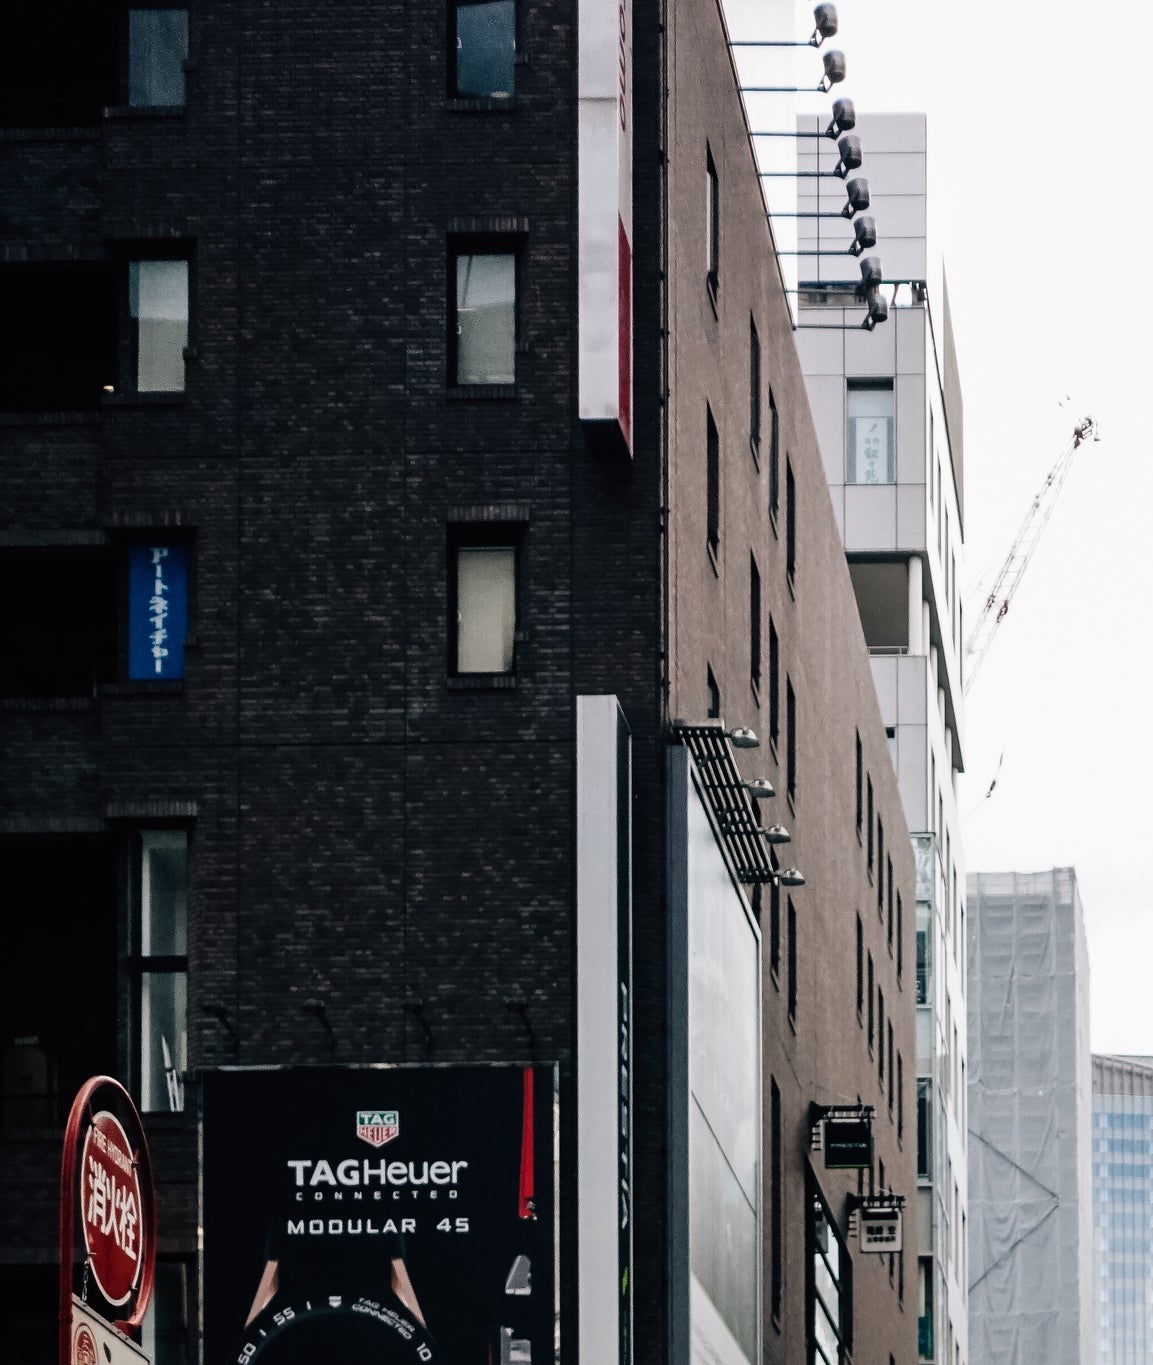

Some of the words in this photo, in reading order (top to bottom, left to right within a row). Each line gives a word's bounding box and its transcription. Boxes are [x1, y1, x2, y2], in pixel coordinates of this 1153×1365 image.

[360, 1113, 395, 1125] TAG
[359, 1126, 398, 1143] HEUER
[295, 1189, 458, 1200] CONNECTED
[88, 1155, 137, 1261] 消火栓
[287, 1218, 416, 1234] MODULAR
[436, 1217, 470, 1233] 45
[273, 1306, 296, 1326] 55
[237, 1342, 257, 1365] 50
[416, 1342, 432, 1361] 10
